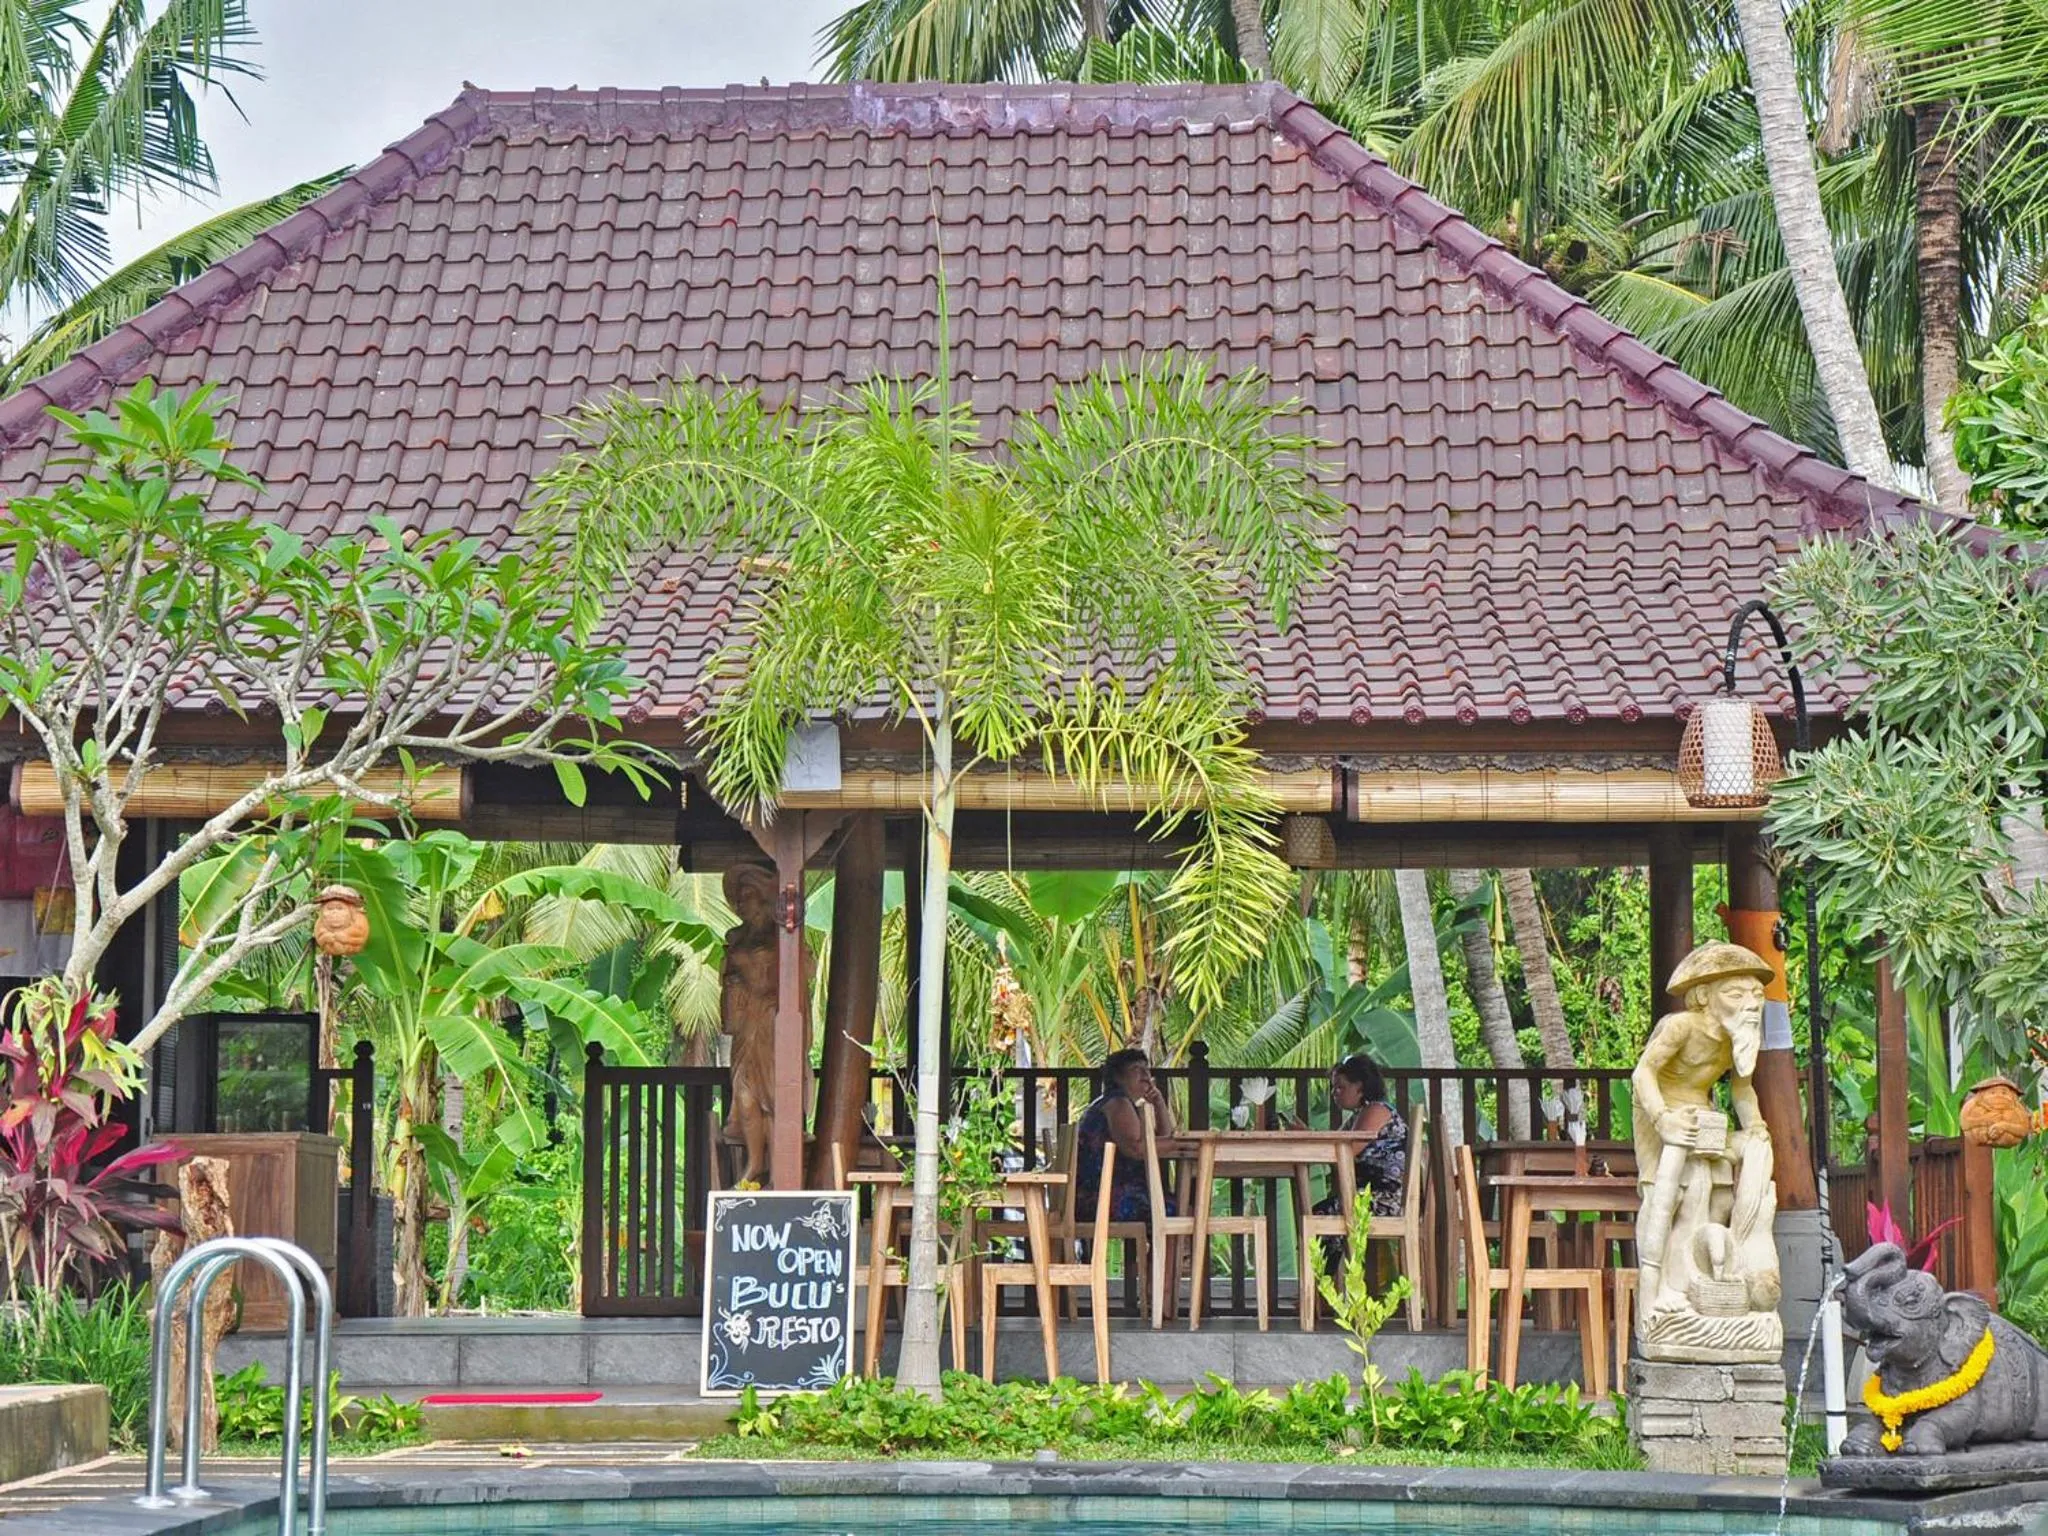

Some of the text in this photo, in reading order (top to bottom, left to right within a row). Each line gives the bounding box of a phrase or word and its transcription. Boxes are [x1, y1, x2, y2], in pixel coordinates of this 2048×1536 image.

[732, 1222, 792, 1252] NOW
[777, 1246, 842, 1277] OPEN
[750, 1316, 841, 1350] RESTO
